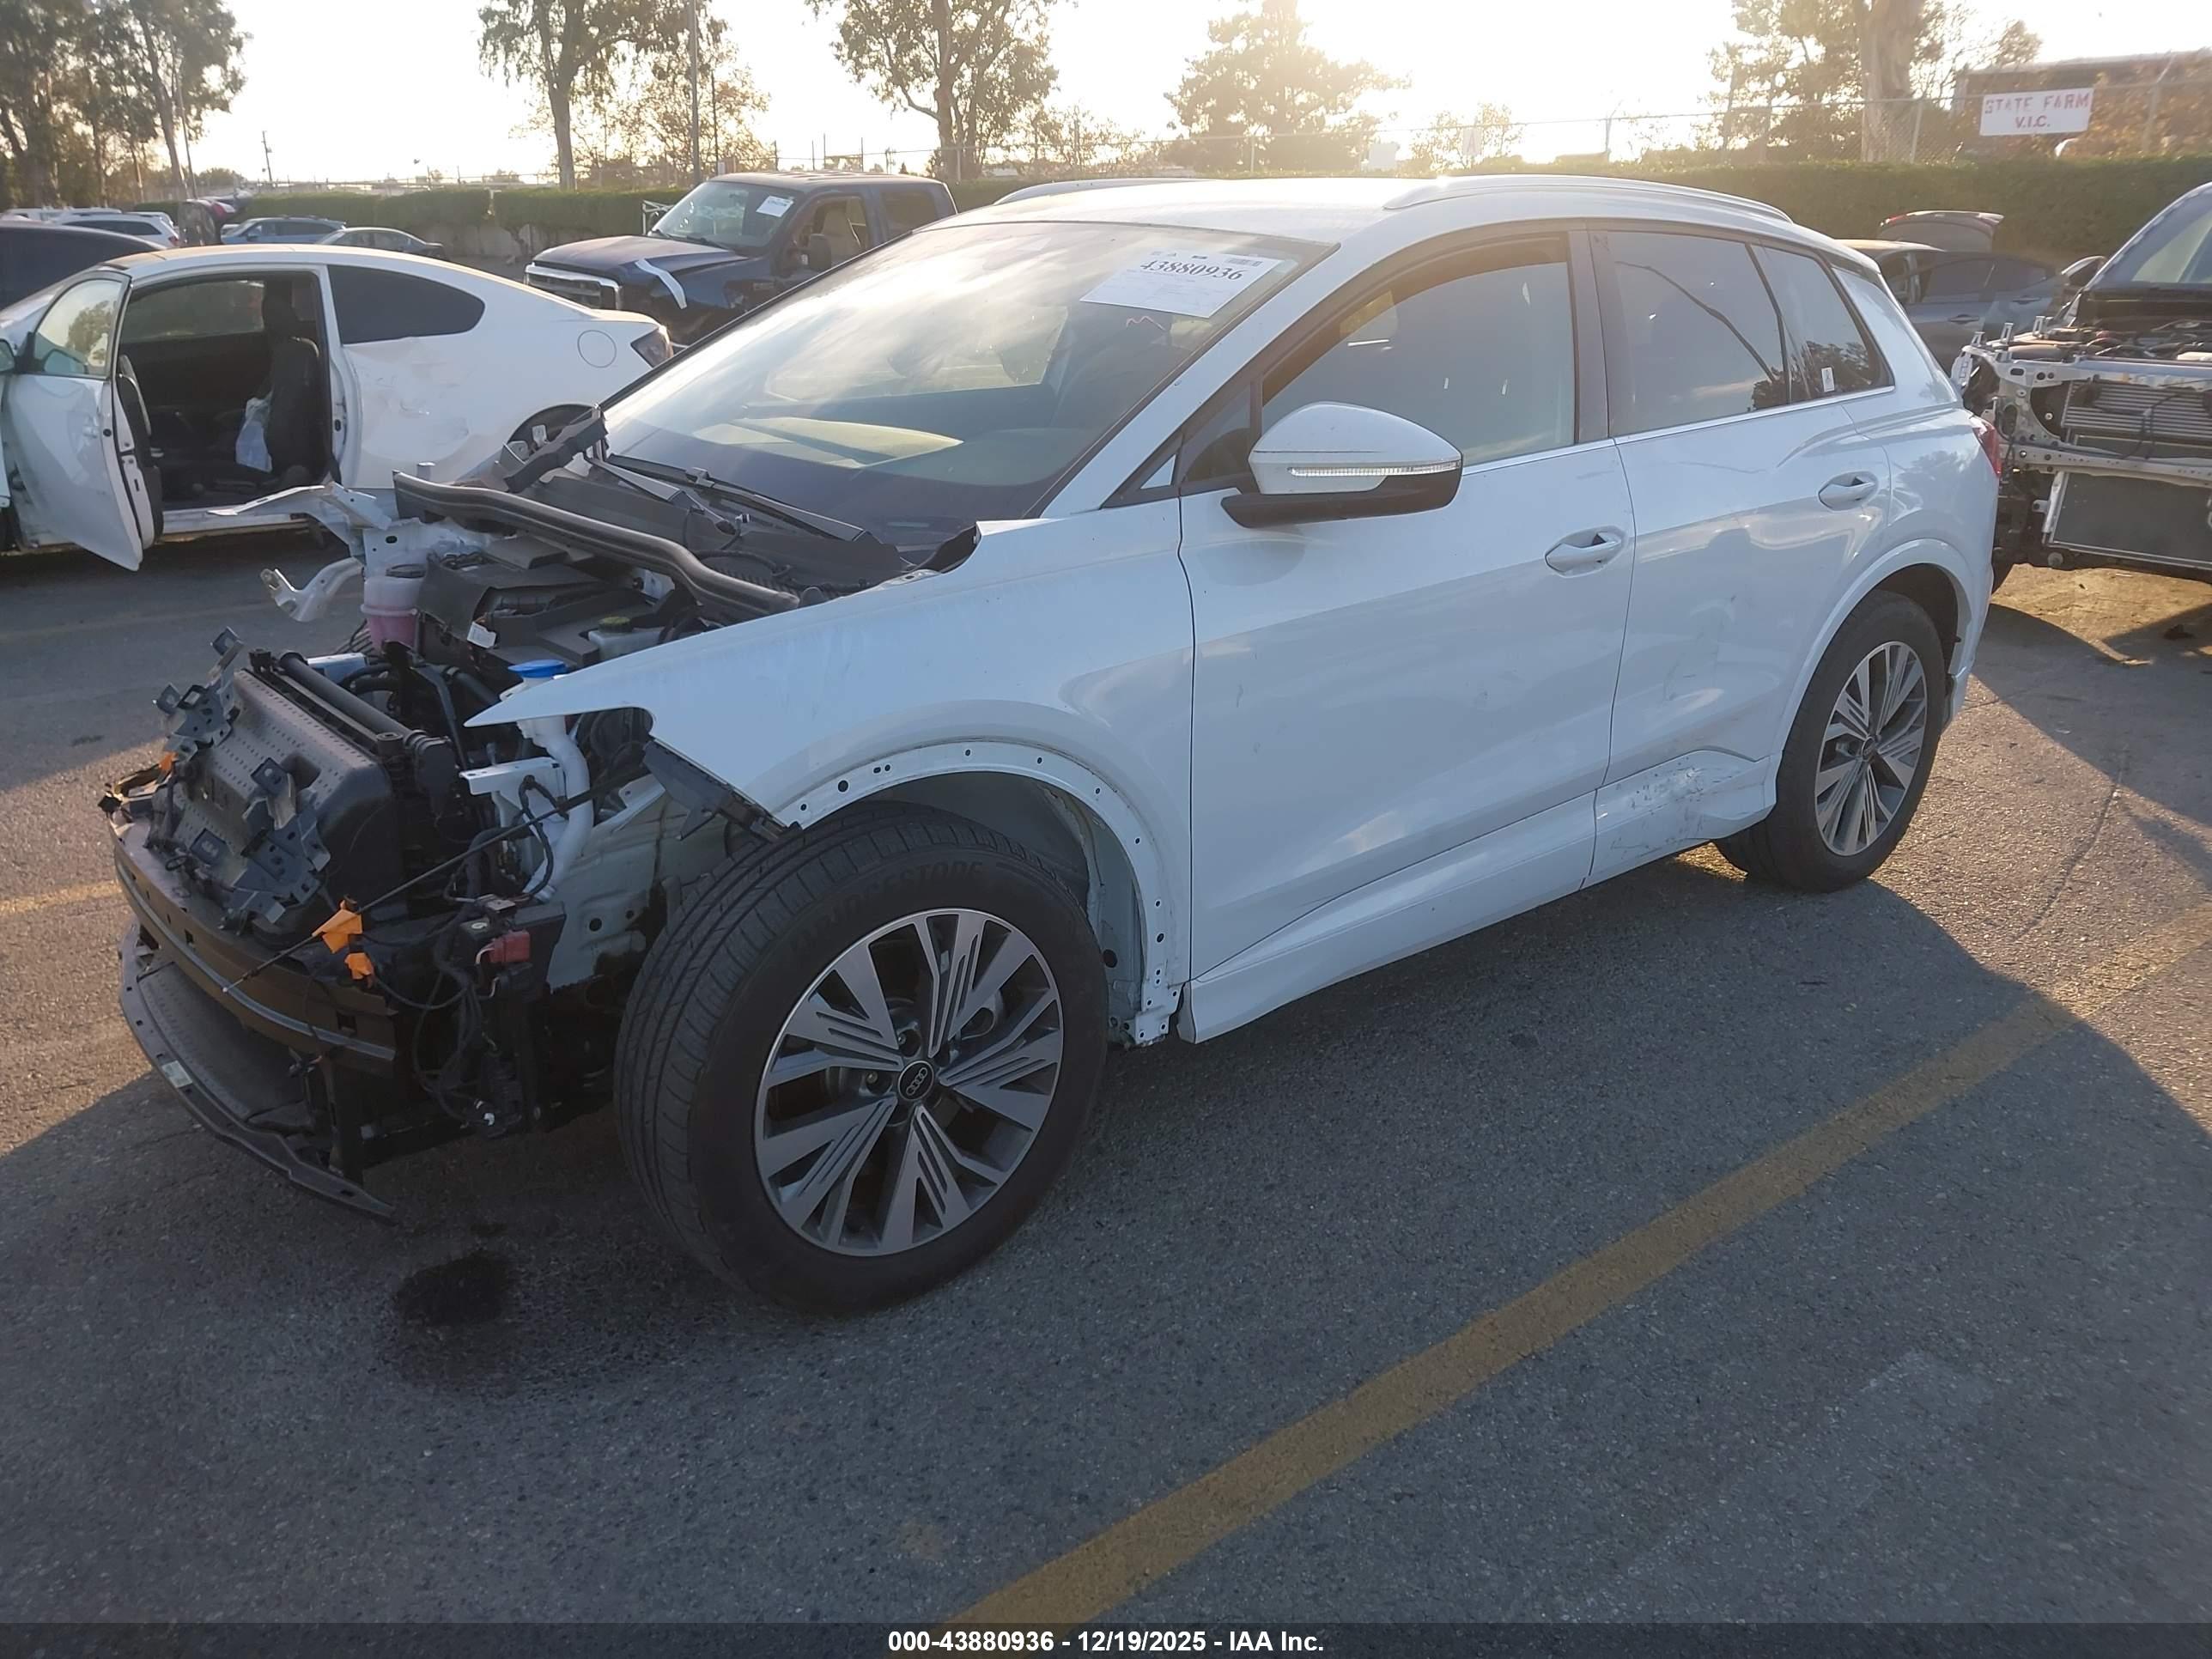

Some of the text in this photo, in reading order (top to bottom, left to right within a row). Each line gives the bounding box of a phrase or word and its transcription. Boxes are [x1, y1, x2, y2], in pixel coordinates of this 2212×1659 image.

[1984, 92, 2089, 114] STATE FARM
[2014, 115, 2051, 129] V.I.C.
[1139, 259, 1249, 281] 43880936
